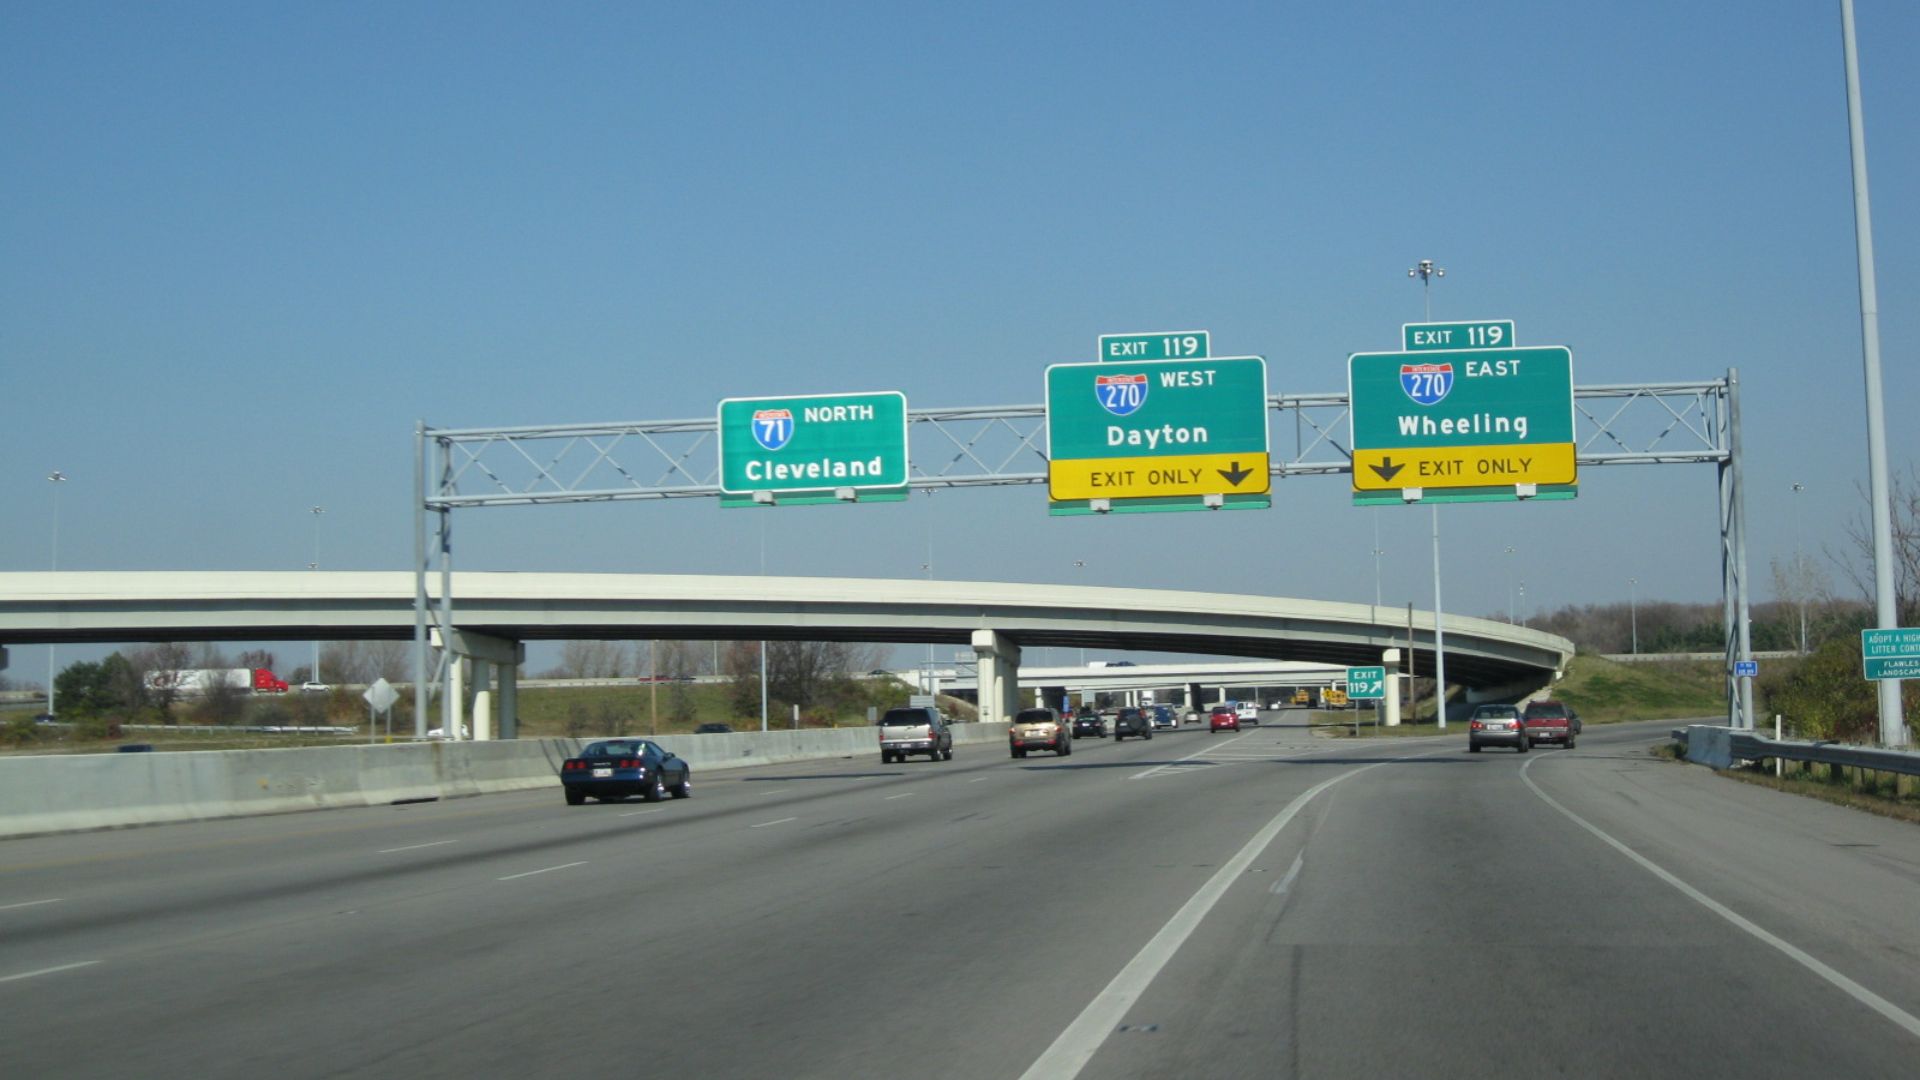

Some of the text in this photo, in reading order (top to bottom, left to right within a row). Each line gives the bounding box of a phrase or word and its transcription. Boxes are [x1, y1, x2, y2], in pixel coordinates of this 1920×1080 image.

[1414, 326, 1503, 345] EXIT 119
[1110, 336, 1199, 356] EXIT 119
[1465, 360, 1521, 377] EAST
[1160, 370, 1216, 387] WEST
[1410, 373, 1446, 398] 270
[1105, 384, 1140, 408] 270
[804, 405, 874, 423] NORTH
[759, 420, 785, 442] 71
[1398, 413, 1528, 439] Wheeling
[1107, 424, 1208, 450] Dayton
[745, 456, 882, 481] Cleveland
[1419, 458, 1533, 476] EXIT ONLY
[1091, 468, 1203, 487] EXIT ONLY
[1868, 634, 1892, 644] ADOPT
[1895, 634, 1901, 642] A
[1871, 644, 1920, 654] LITTER CONT
[1353, 671, 1377, 680] EXIT
[1877, 668, 1920, 676] LANDSCAP
[1349, 682, 1368, 693] 119
